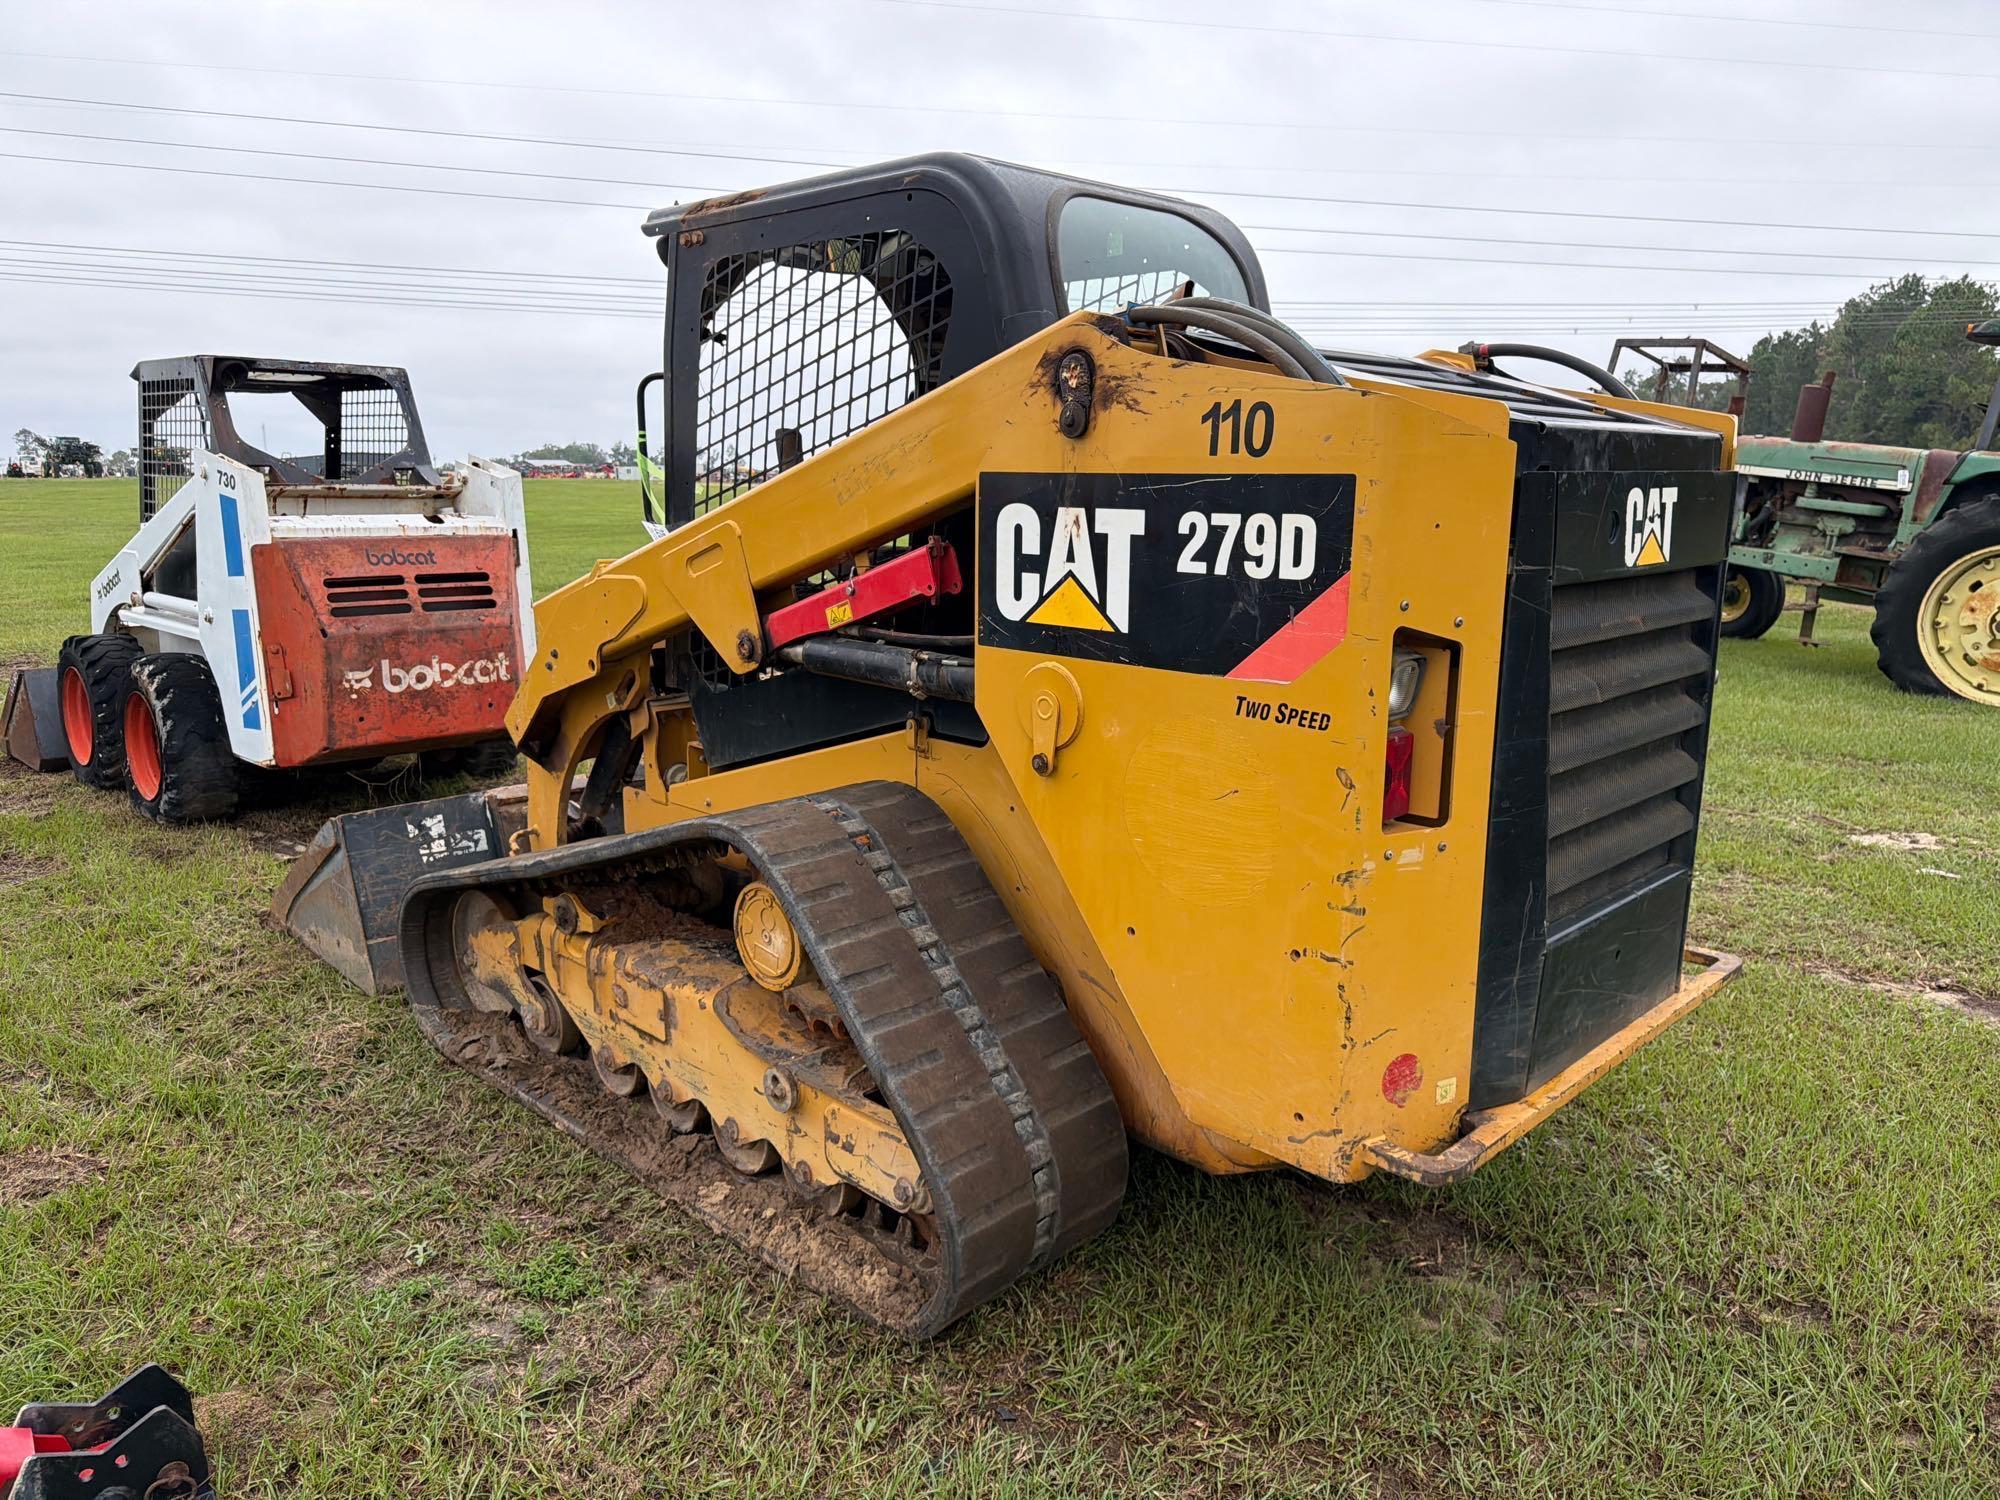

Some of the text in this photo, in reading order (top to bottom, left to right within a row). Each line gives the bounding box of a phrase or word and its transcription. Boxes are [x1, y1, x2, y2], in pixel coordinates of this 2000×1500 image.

[1201, 399, 1275, 458] 110
[216, 469, 236, 490] 730
[1786, 470, 1878, 488] JOHN DEERE
[1625, 486, 1678, 567] CAT
[365, 548, 437, 566] bobcat
[996, 503, 1317, 633] CAT 279D
[381, 652, 511, 693] bobcat
